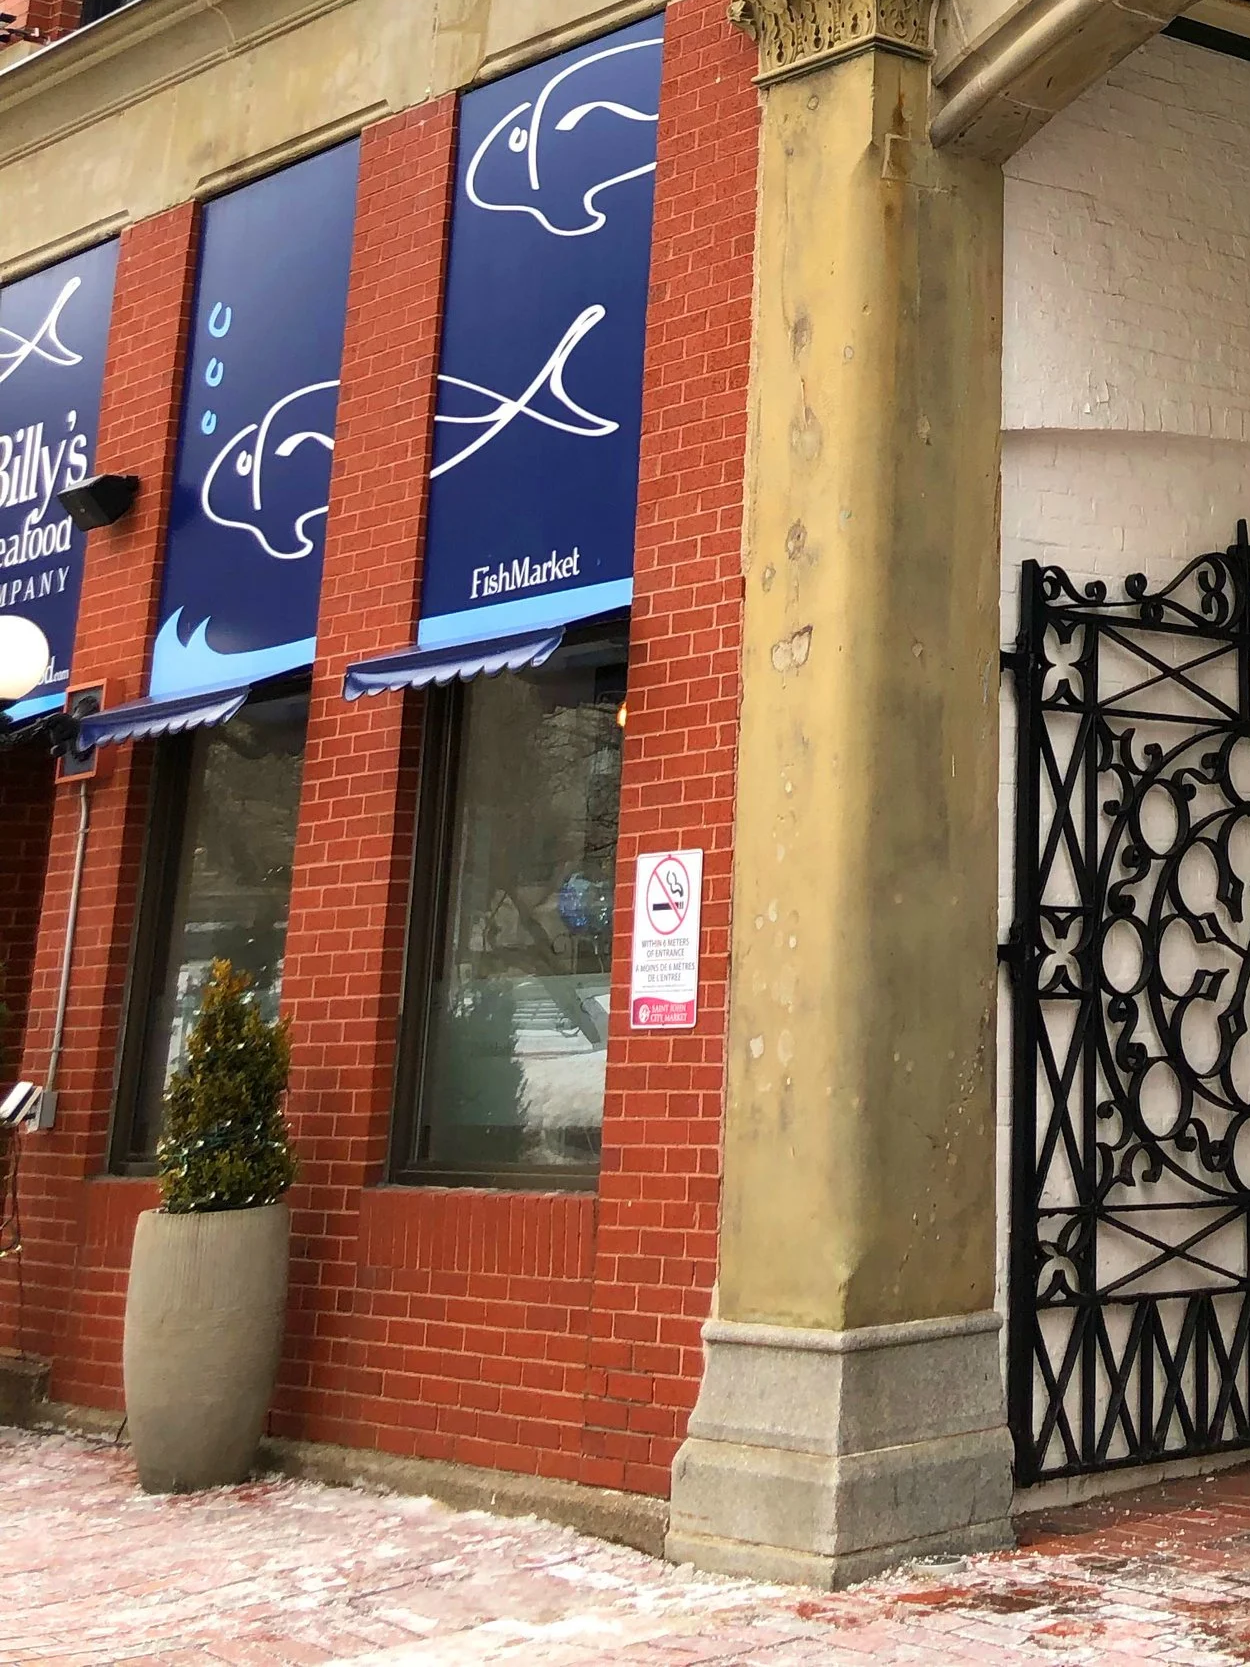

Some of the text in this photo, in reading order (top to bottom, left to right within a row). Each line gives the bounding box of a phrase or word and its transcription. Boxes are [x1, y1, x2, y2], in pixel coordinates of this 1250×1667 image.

[469, 546, 581, 600] FishMarket
[641, 938, 690, 948] WITHIN 6 METERS
[646, 948, 685, 958] OF ENTRANCE
[660, 963, 668, 971] DE
[647, 974, 655, 982] DE
[652, 1003, 687, 1013] SAINT JOHN
[650, 1013, 688, 1022] CITY MARKET
